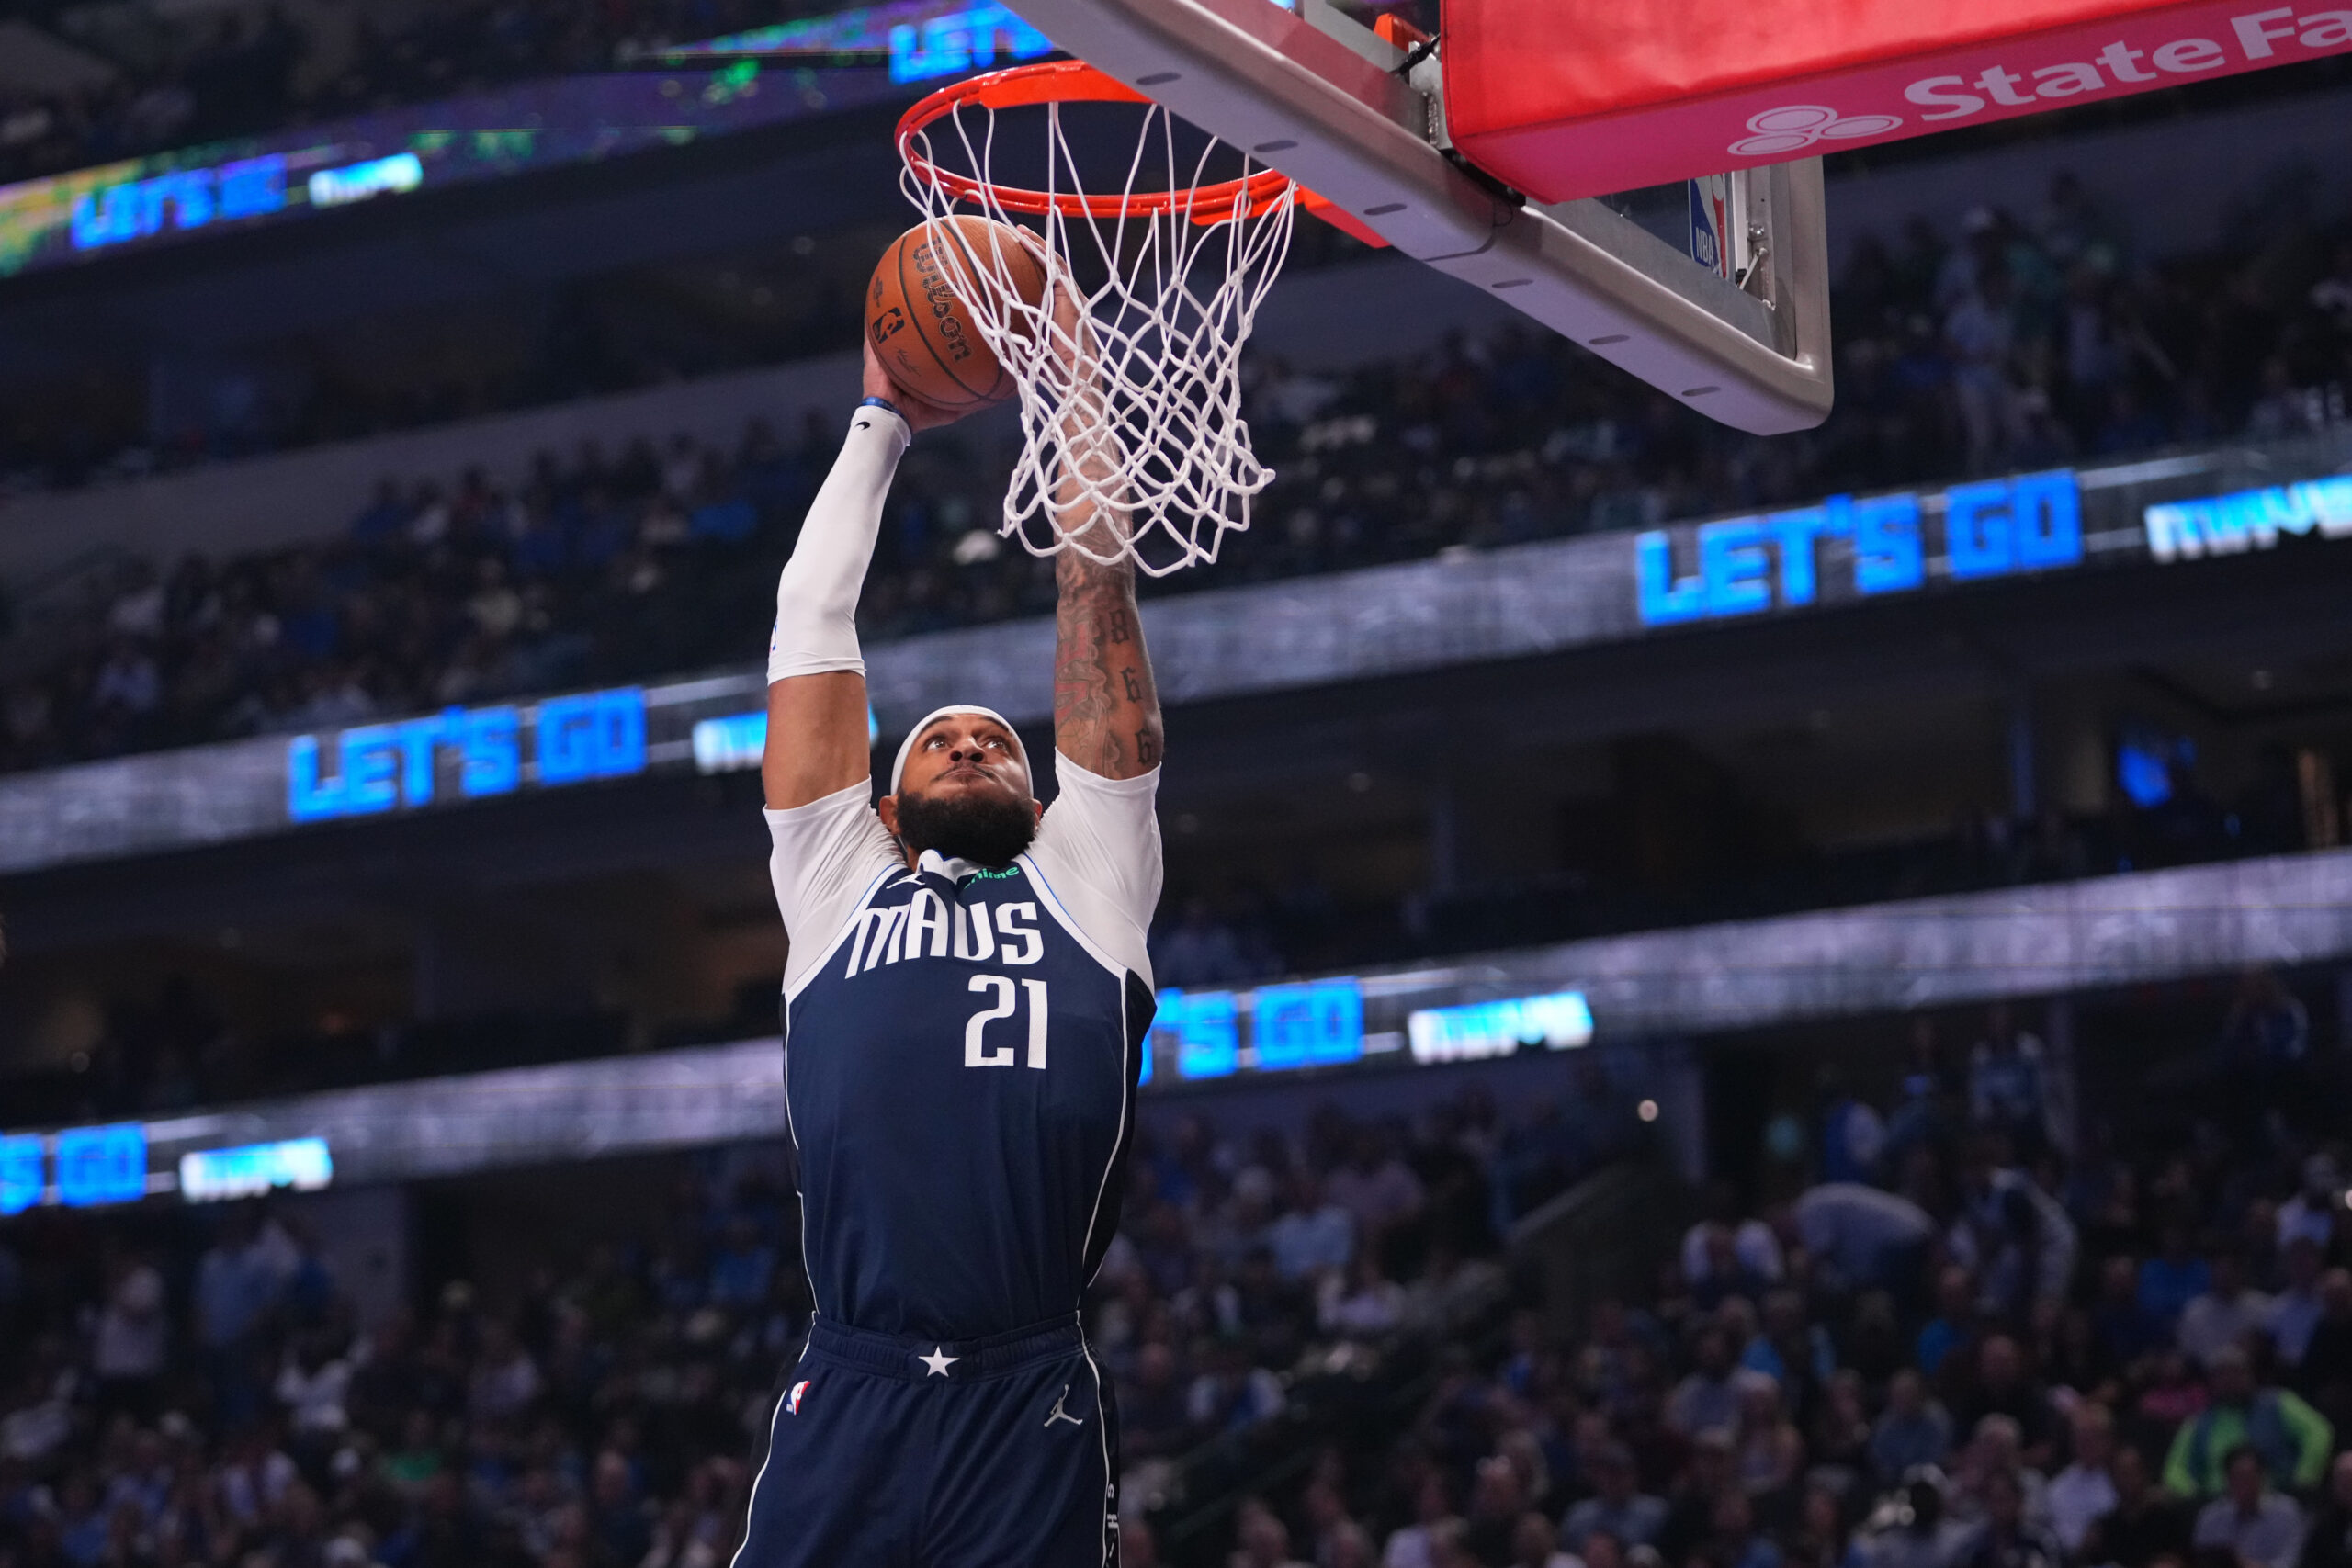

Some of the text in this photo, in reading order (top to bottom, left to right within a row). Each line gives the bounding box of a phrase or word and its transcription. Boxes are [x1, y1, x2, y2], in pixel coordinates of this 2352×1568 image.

[1904, 38, 2226, 121] State
[1695, 226, 1715, 267] NBA
[1635, 493, 1928, 627] LET'S
[1945, 468, 2083, 581] GO
[288, 705, 521, 824] LET'S
[537, 685, 648, 787] GO
[965, 974, 1048, 1070] 21
[1252, 975, 1365, 1073] GO
